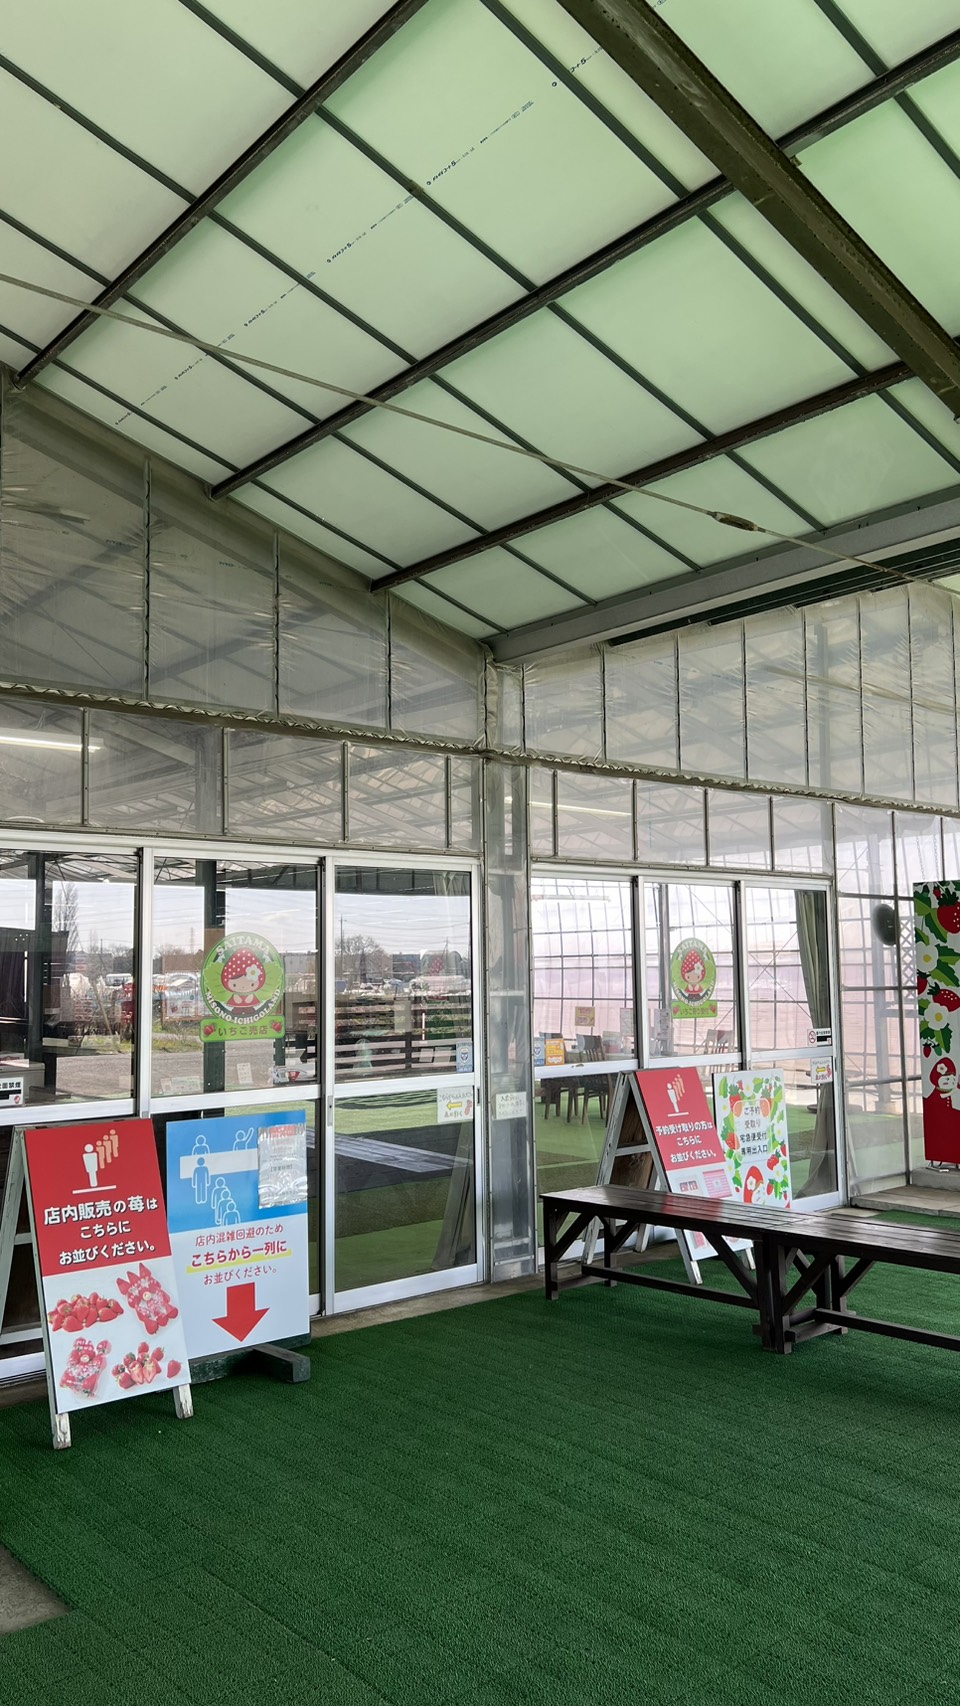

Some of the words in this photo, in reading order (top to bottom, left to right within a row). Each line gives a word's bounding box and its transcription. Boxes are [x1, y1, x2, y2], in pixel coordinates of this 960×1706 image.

[215, 935, 270, 956] SAITAMA
[205, 991, 233, 1022] MISONO
[234, 988, 280, 1025] ICHIGOLAND
[218, 1025, 268, 1037] いちご売店
[743, 1105, 760, 1116] ご予約
[656, 1121, 713, 1136] 予約受け取りの方は
[744, 1119, 760, 1130] 受取り
[677, 1135, 702, 1147] こちらに
[740, 1131, 767, 1143] 宅急便受付
[670, 1150, 717, 1163] お並びください。
[44, 1195, 159, 1225] 店内販売の苺は
[80, 1220, 131, 1239] こちらに
[195, 1223, 284, 1247] 店内混雑回避のため
[59, 1240, 155, 1266] お並びください。
[191, 1240, 287, 1268] こちらから一列に
[203, 1264, 277, 1286] お並びください。
